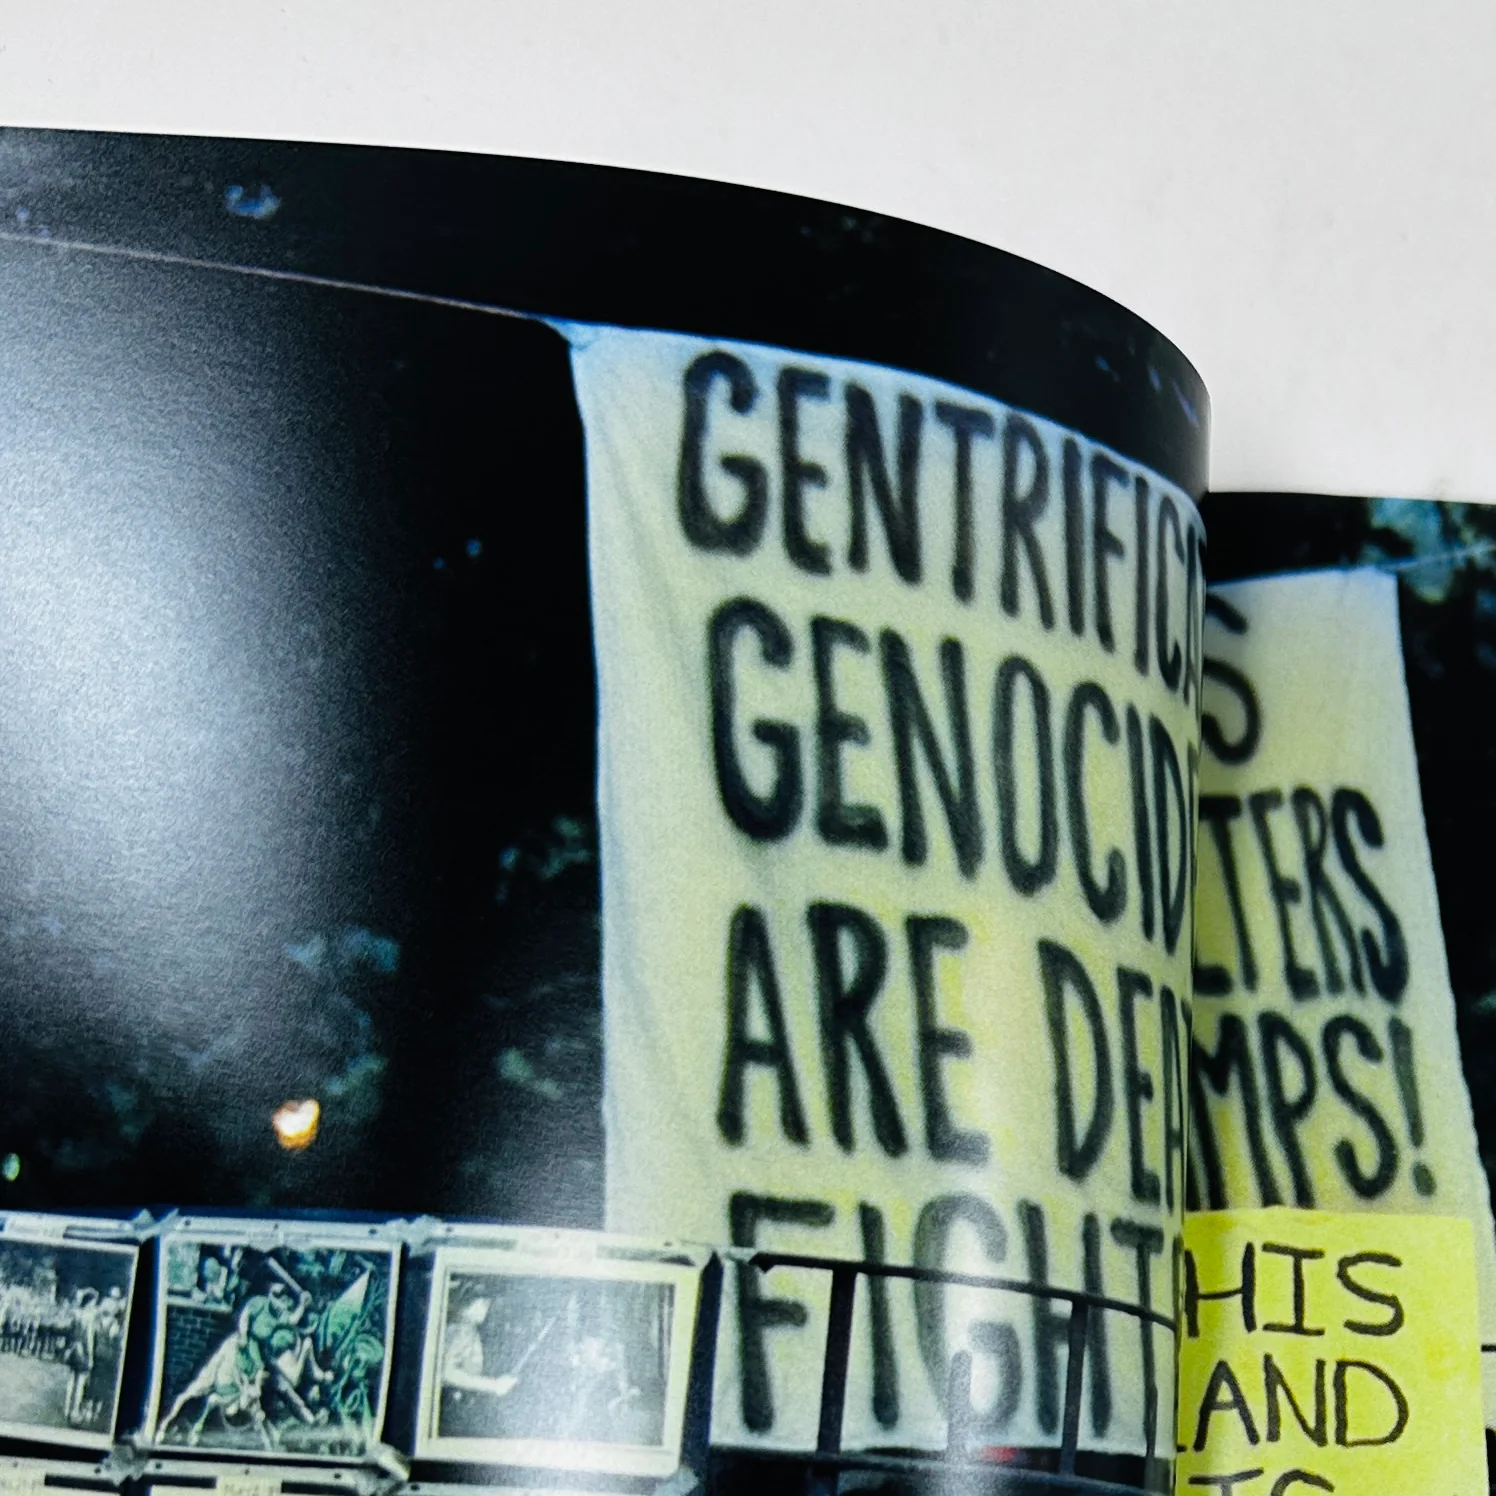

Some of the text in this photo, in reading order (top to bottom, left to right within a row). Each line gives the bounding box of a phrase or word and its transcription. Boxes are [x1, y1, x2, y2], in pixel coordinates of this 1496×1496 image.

[717, 900, 990, 1164] ARE
[729, 1190, 1164, 1440] FIGHT
[1177, 1353, 1409, 1452] AND
